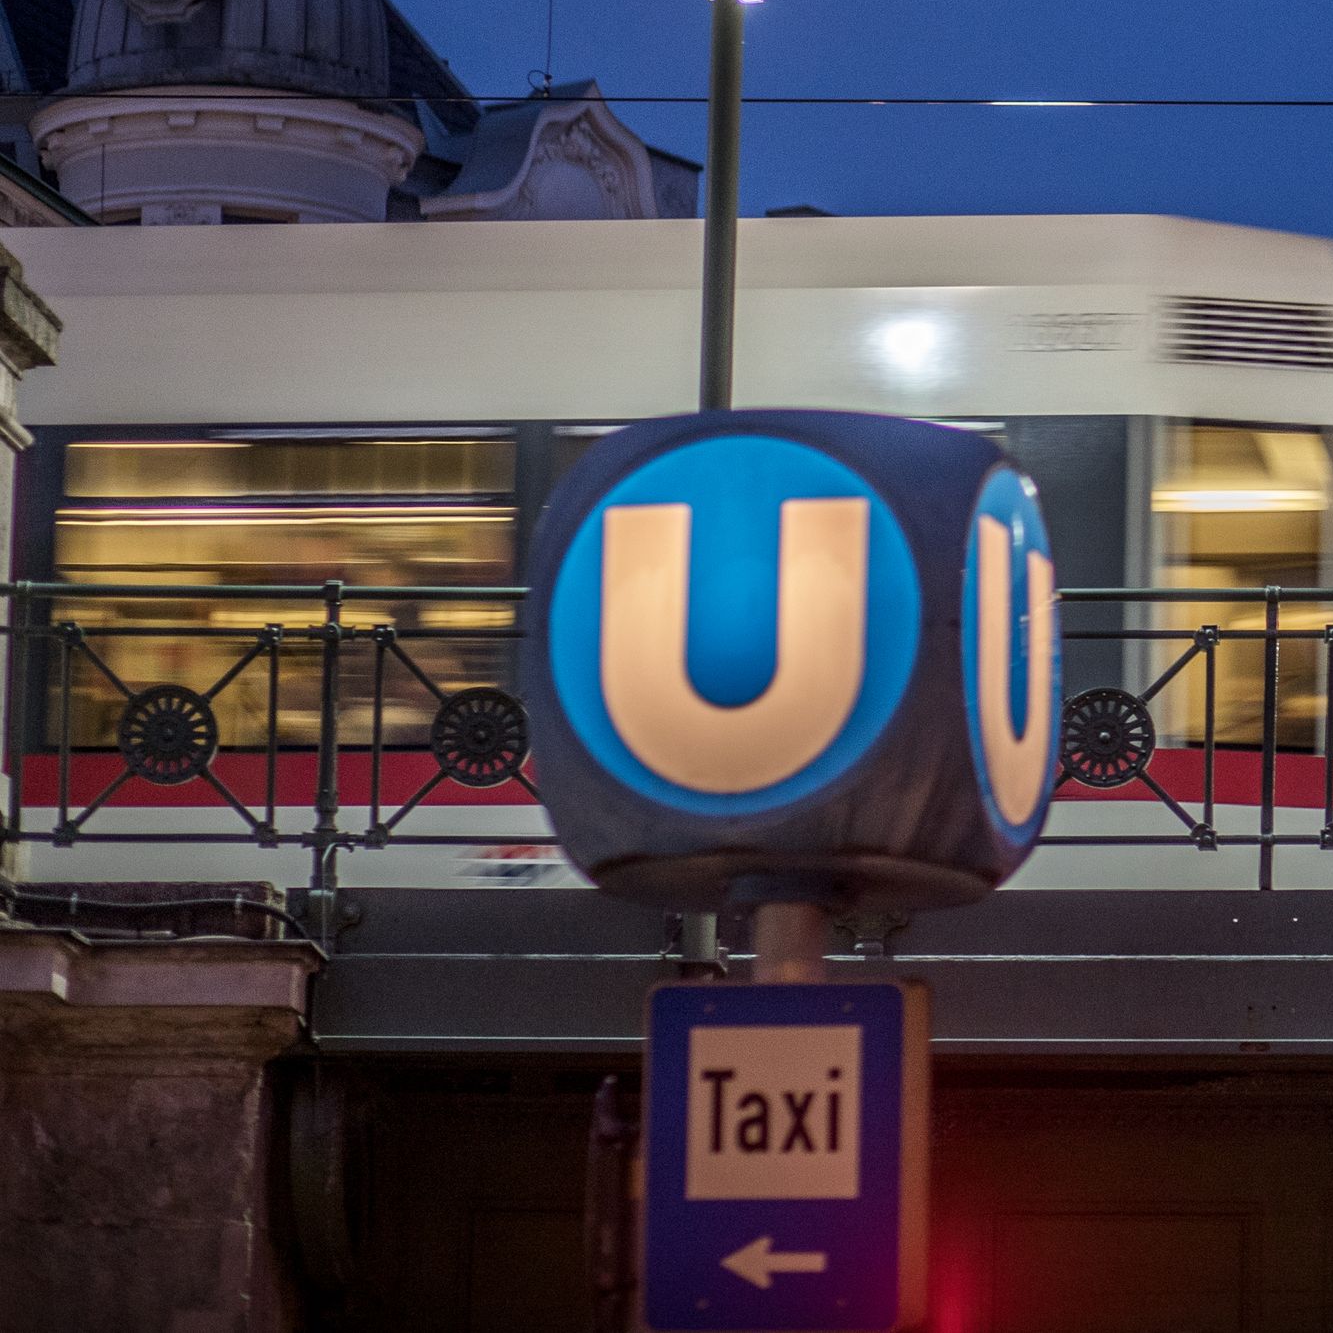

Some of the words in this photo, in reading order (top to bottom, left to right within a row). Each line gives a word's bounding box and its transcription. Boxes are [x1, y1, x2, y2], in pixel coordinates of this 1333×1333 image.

[602, 498, 868, 793] U
[978, 515, 1053, 825] U
[701, 1068, 842, 1154] Taxi
